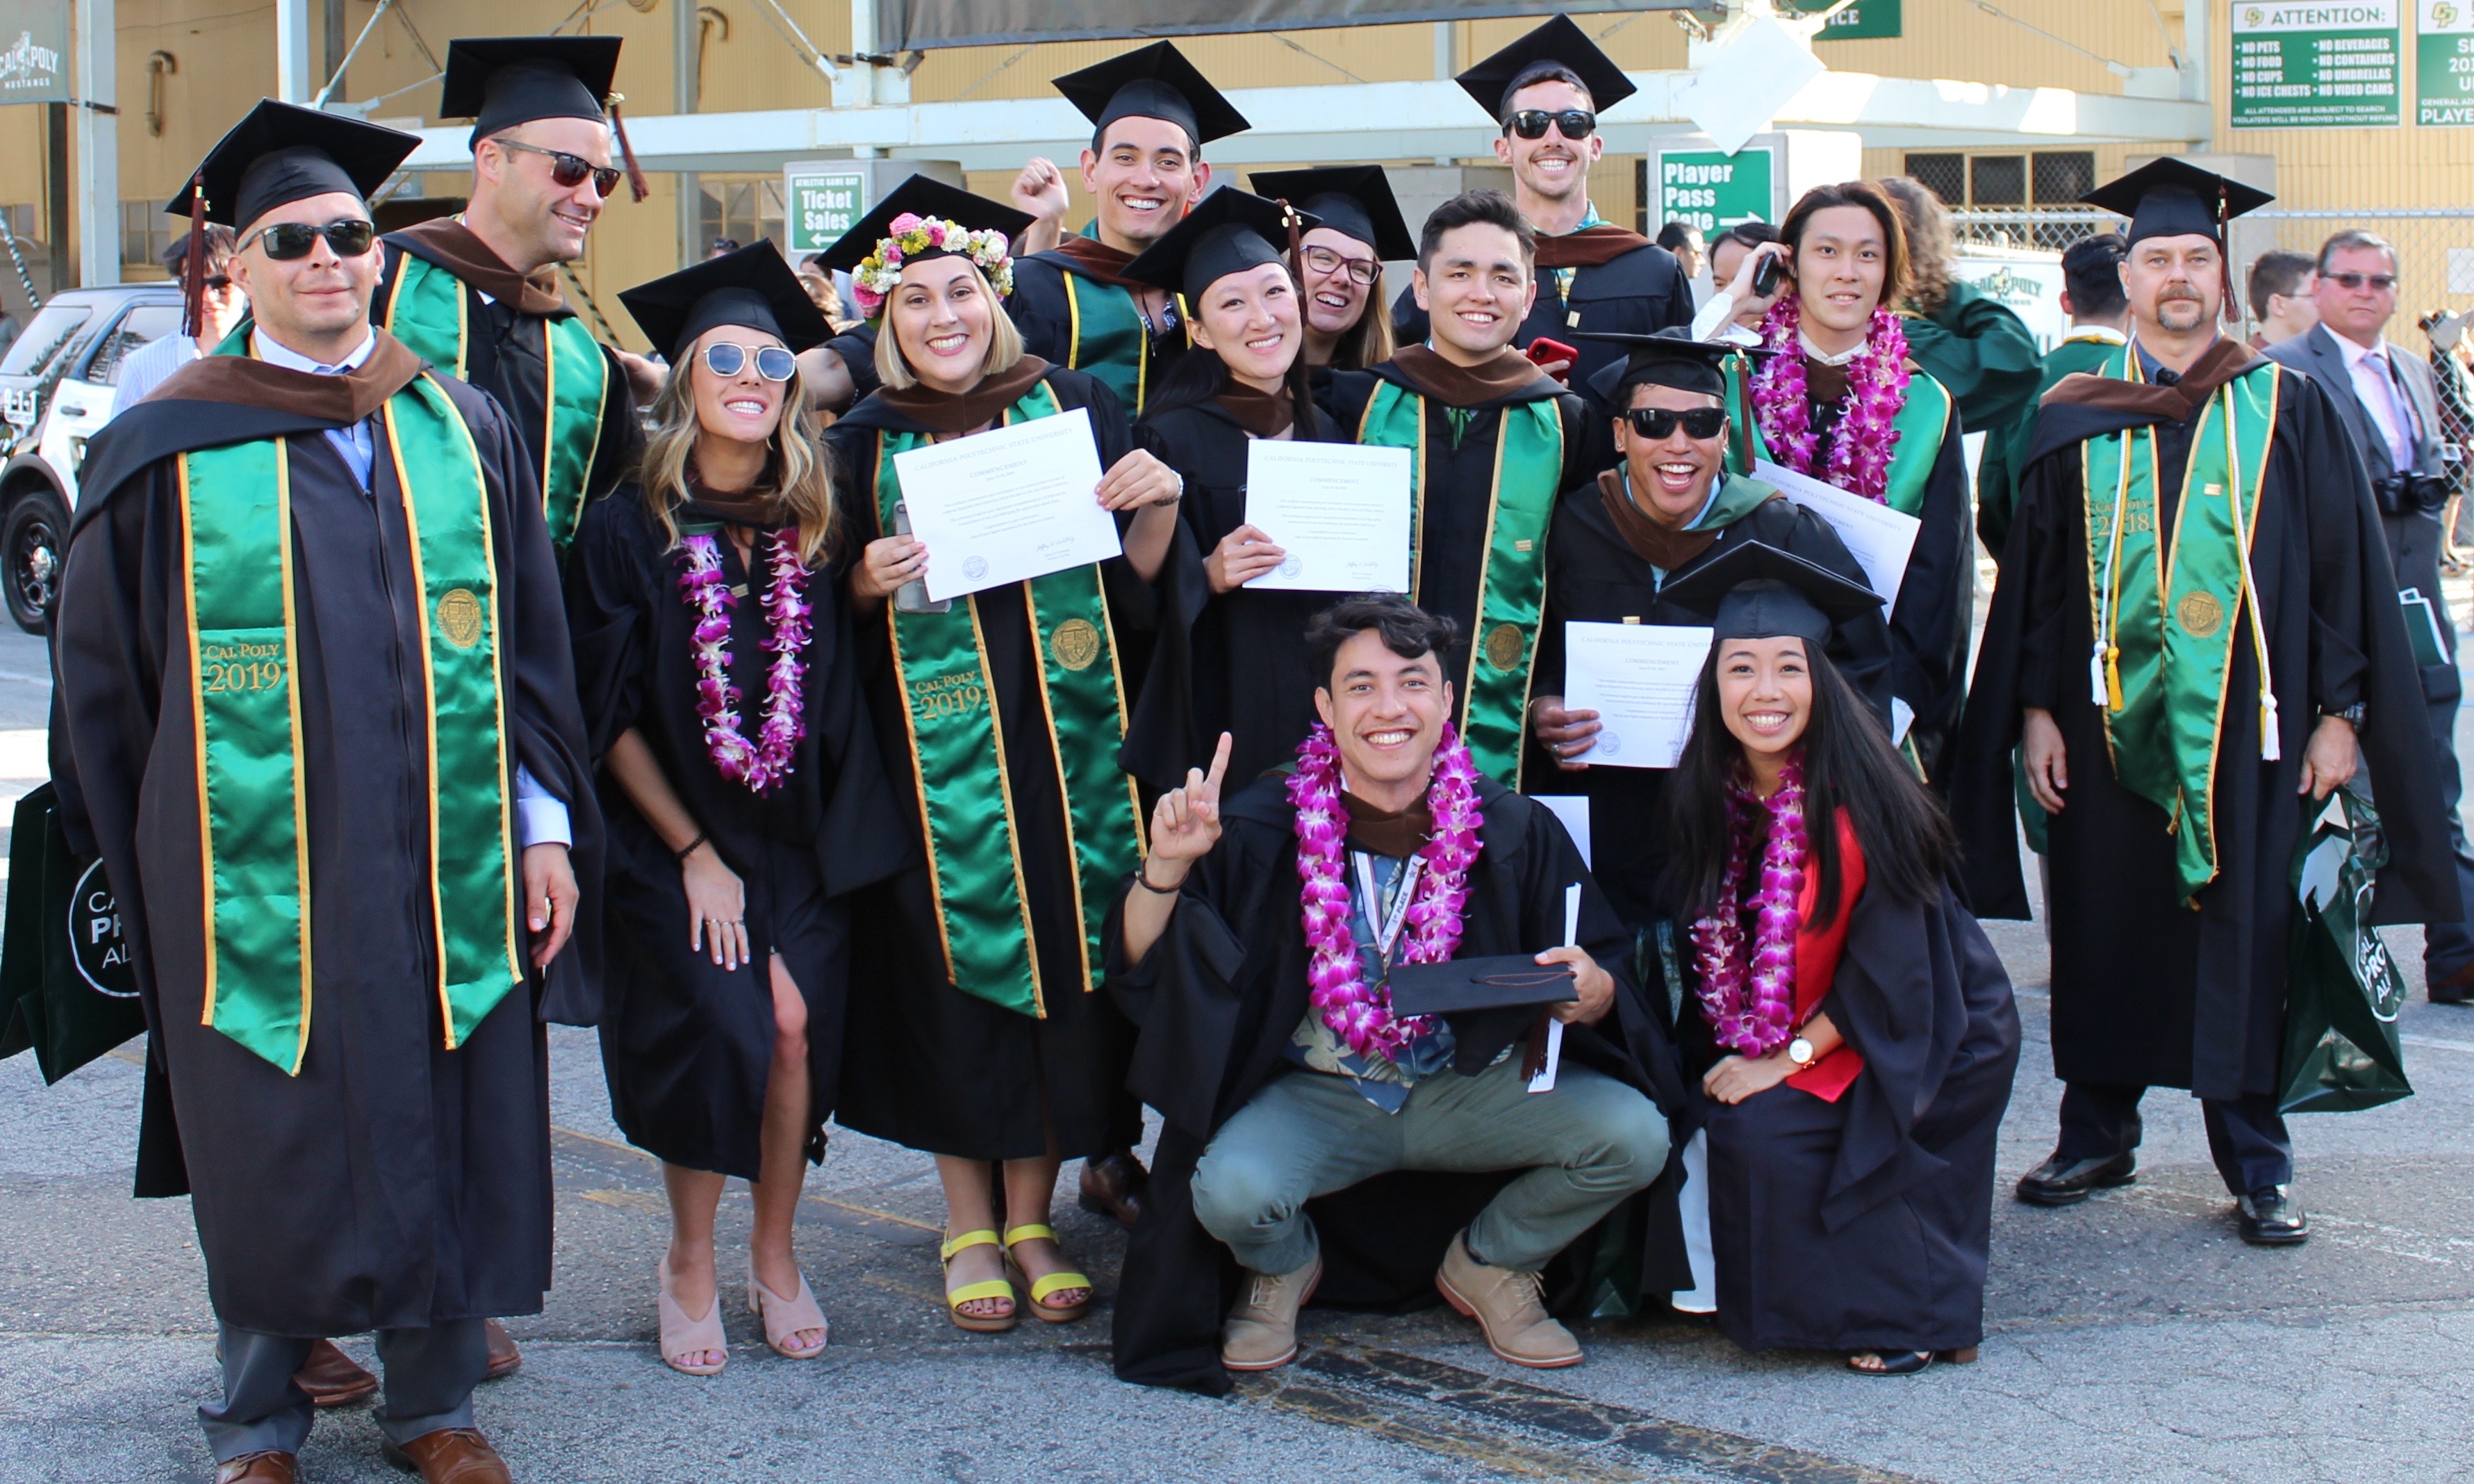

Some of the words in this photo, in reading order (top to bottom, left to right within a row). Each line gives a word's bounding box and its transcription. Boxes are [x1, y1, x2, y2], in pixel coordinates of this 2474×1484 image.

[2272, 7, 2386, 26] ATTENTION:
[2241, 41, 2256, 54] NO
[2257, 40, 2281, 53] PETS
[2319, 39, 2333, 52] NO
[2334, 38, 2390, 51] BEVERAGES
[31, 44, 58, 74] POLY
[2241, 56, 2256, 68] NO
[2257, 55, 2283, 68] FOOD
[2319, 54, 2333, 67] NO
[2334, 53, 2395, 67] CONTAINERS
[2241, 71, 2256, 83] NO
[2257, 70, 2284, 83] CUPS
[2319, 69, 2333, 81] NO
[2334, 67, 2392, 81] UMBRELLAS
[2241, 85, 2256, 97] NO
[2257, 85, 2273, 97] ICE
[2273, 84, 2312, 97] CHESTS
[2319, 84, 2333, 97] NO
[2334, 83, 2364, 96] VIDEO
[2365, 83, 2395, 95] CAMS
[1664, 163, 1733, 186] Player
[801, 190, 852, 209] Ticket
[1665, 186, 1716, 208] Pass
[804, 211, 850, 231] Sales
[914, 456, 959, 472] CALIFORNIA
[959, 444, 1008, 462] POLYTECHNIC
[1008, 438, 1031, 450] STATE
[1030, 427, 1074, 444] UNIVERSITY
[968, 459, 1028, 479] COMMENCEMENT
[1305, 456, 1347, 465] POLYTECHNIC
[2097, 513, 2150, 536] 218
[1581, 636, 1619, 645] CALIFORNIA
[1621, 638, 1664, 647] POLYTECHNIC
[208, 661, 281, 691] 2019
[920, 686, 981, 719] 2019
